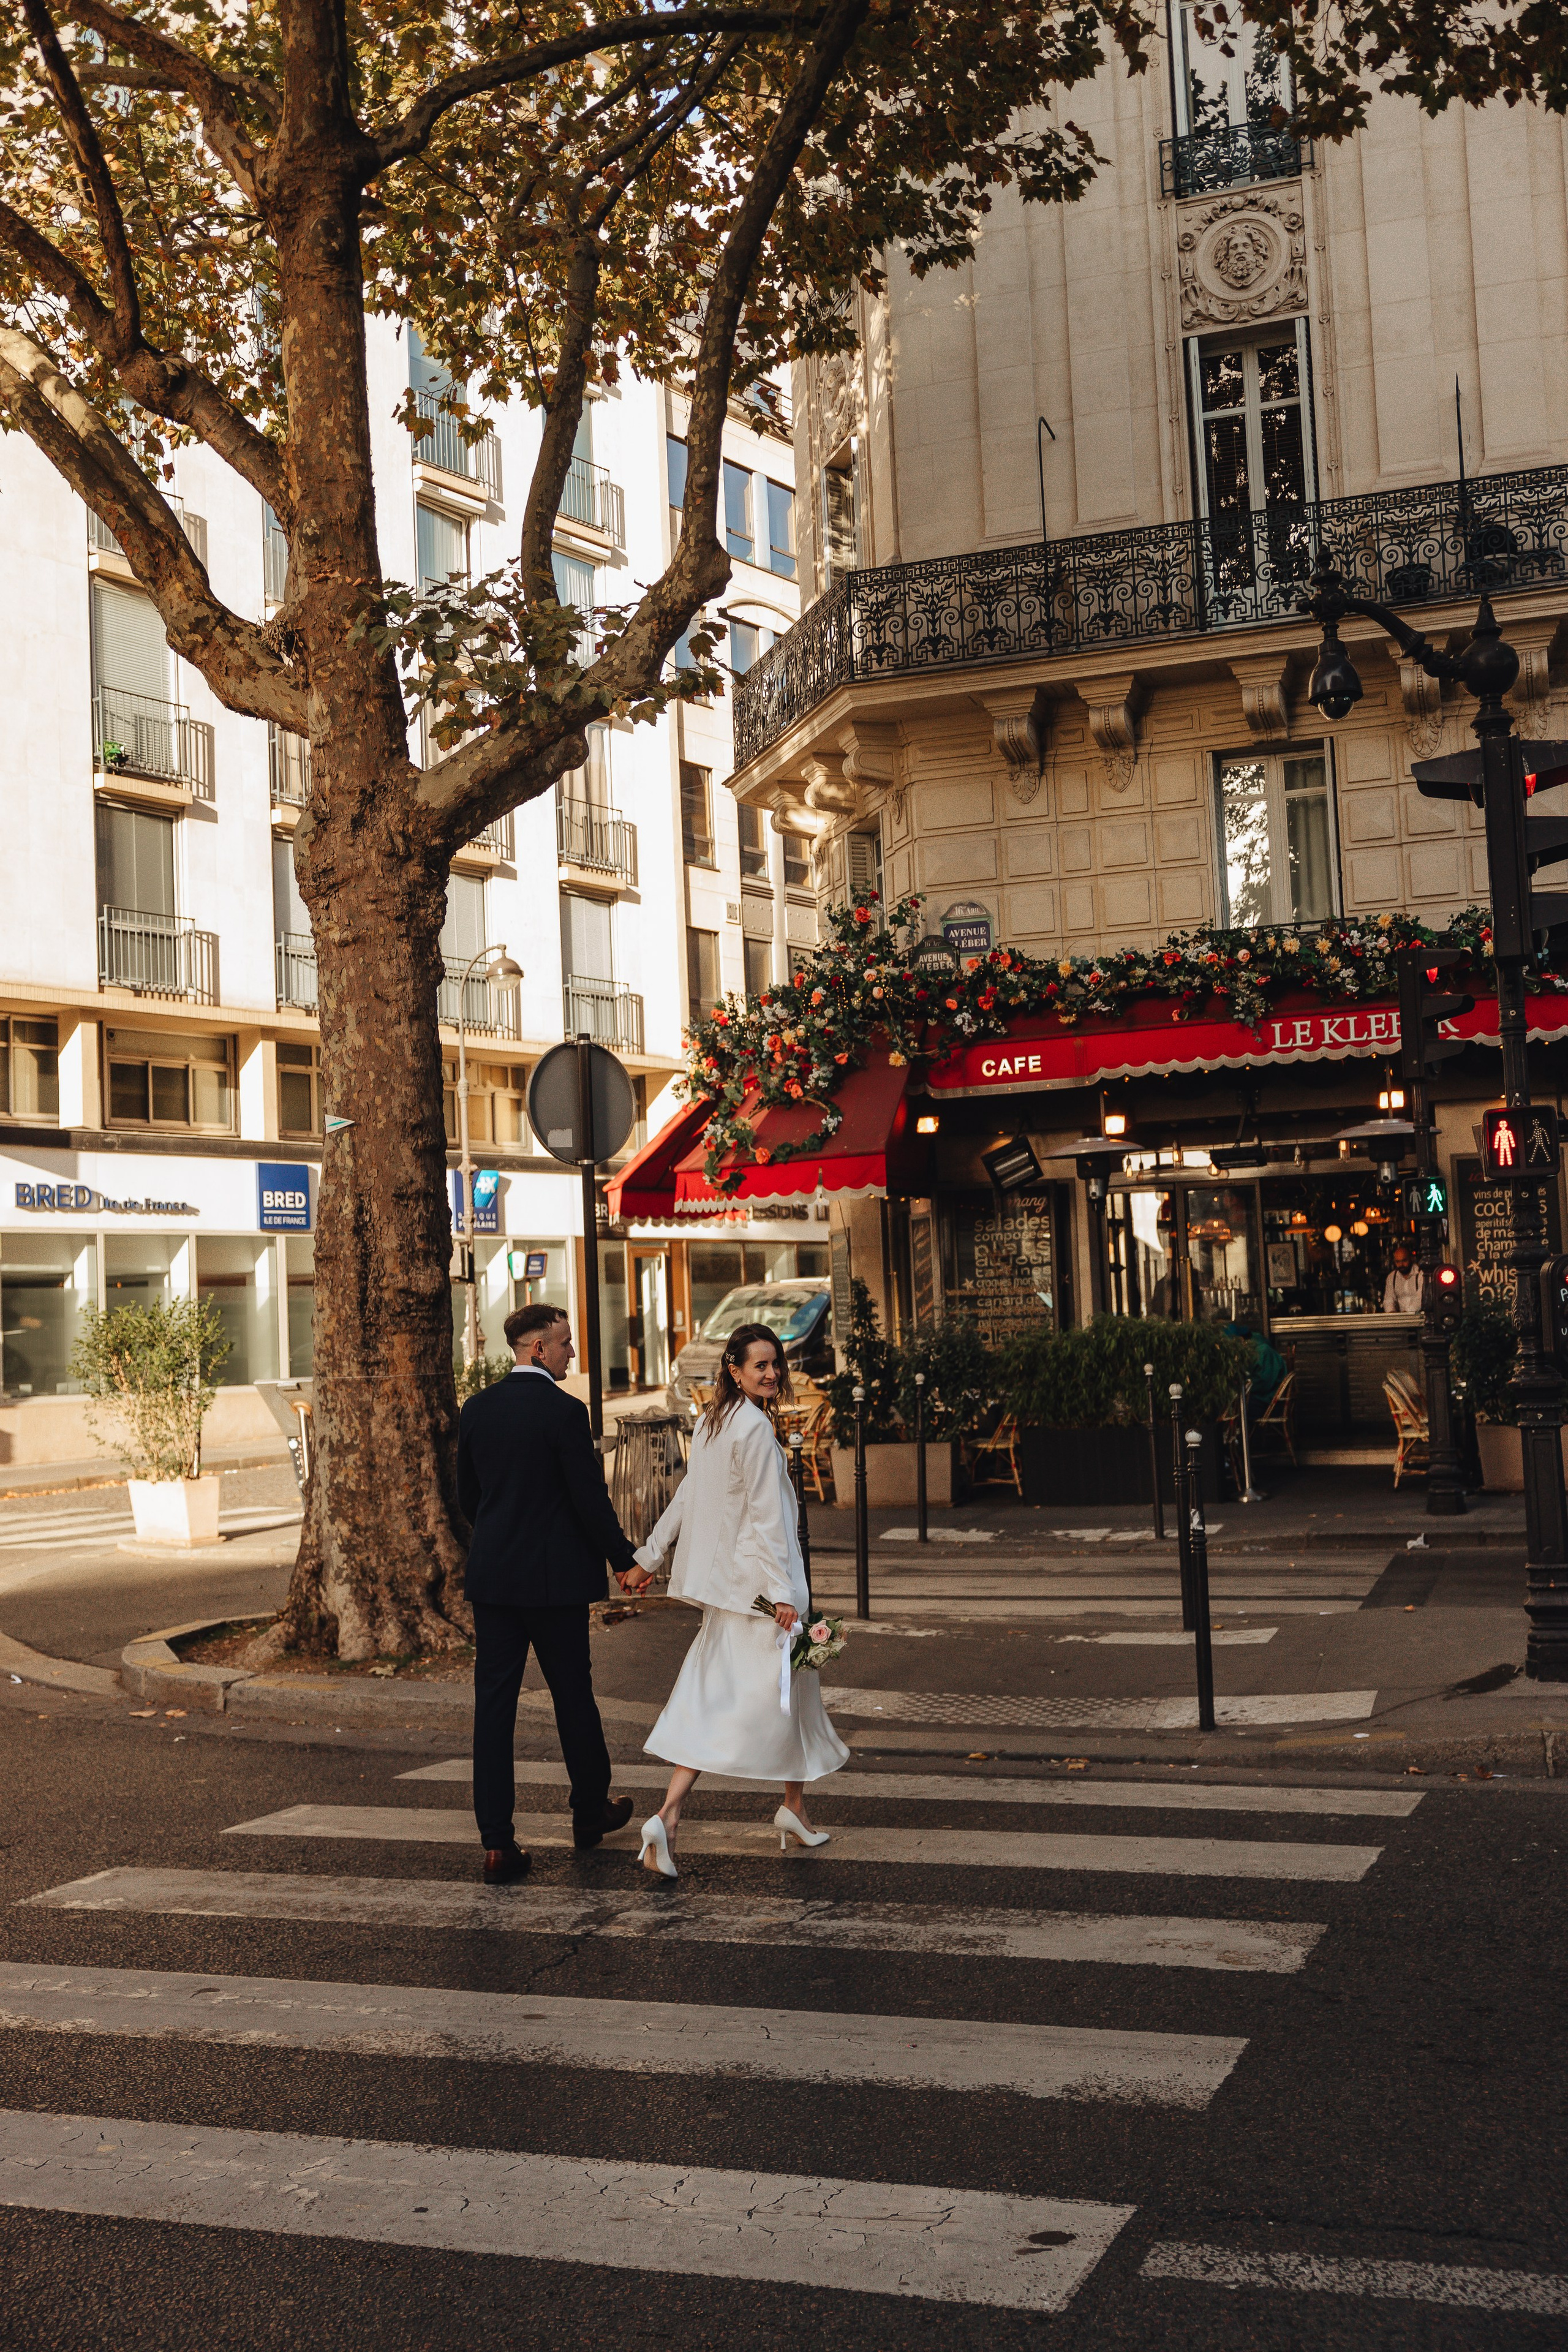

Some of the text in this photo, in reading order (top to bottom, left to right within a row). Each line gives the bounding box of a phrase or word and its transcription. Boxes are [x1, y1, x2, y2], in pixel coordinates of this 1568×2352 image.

[949, 927, 986, 938] AVENUE
[949, 937, 987, 948] LÉBER
[919, 952, 948, 963] AVENUE
[1271, 1020, 1314, 1049] LE
[981, 1055, 1042, 1077] CAFE
[15, 1183, 92, 1208] BRED
[145, 1197, 188, 1211] France
[263, 1191, 307, 1208] BRED
[1474, 1189, 1491, 1200] vins
[1493, 1187, 1503, 1199] de
[263, 1216, 307, 1225] ILE DE FRANCE
[458, 1212, 496, 1221] BQUE
[974, 1211, 1050, 1232] salades
[1476, 1225, 1491, 1239] de
